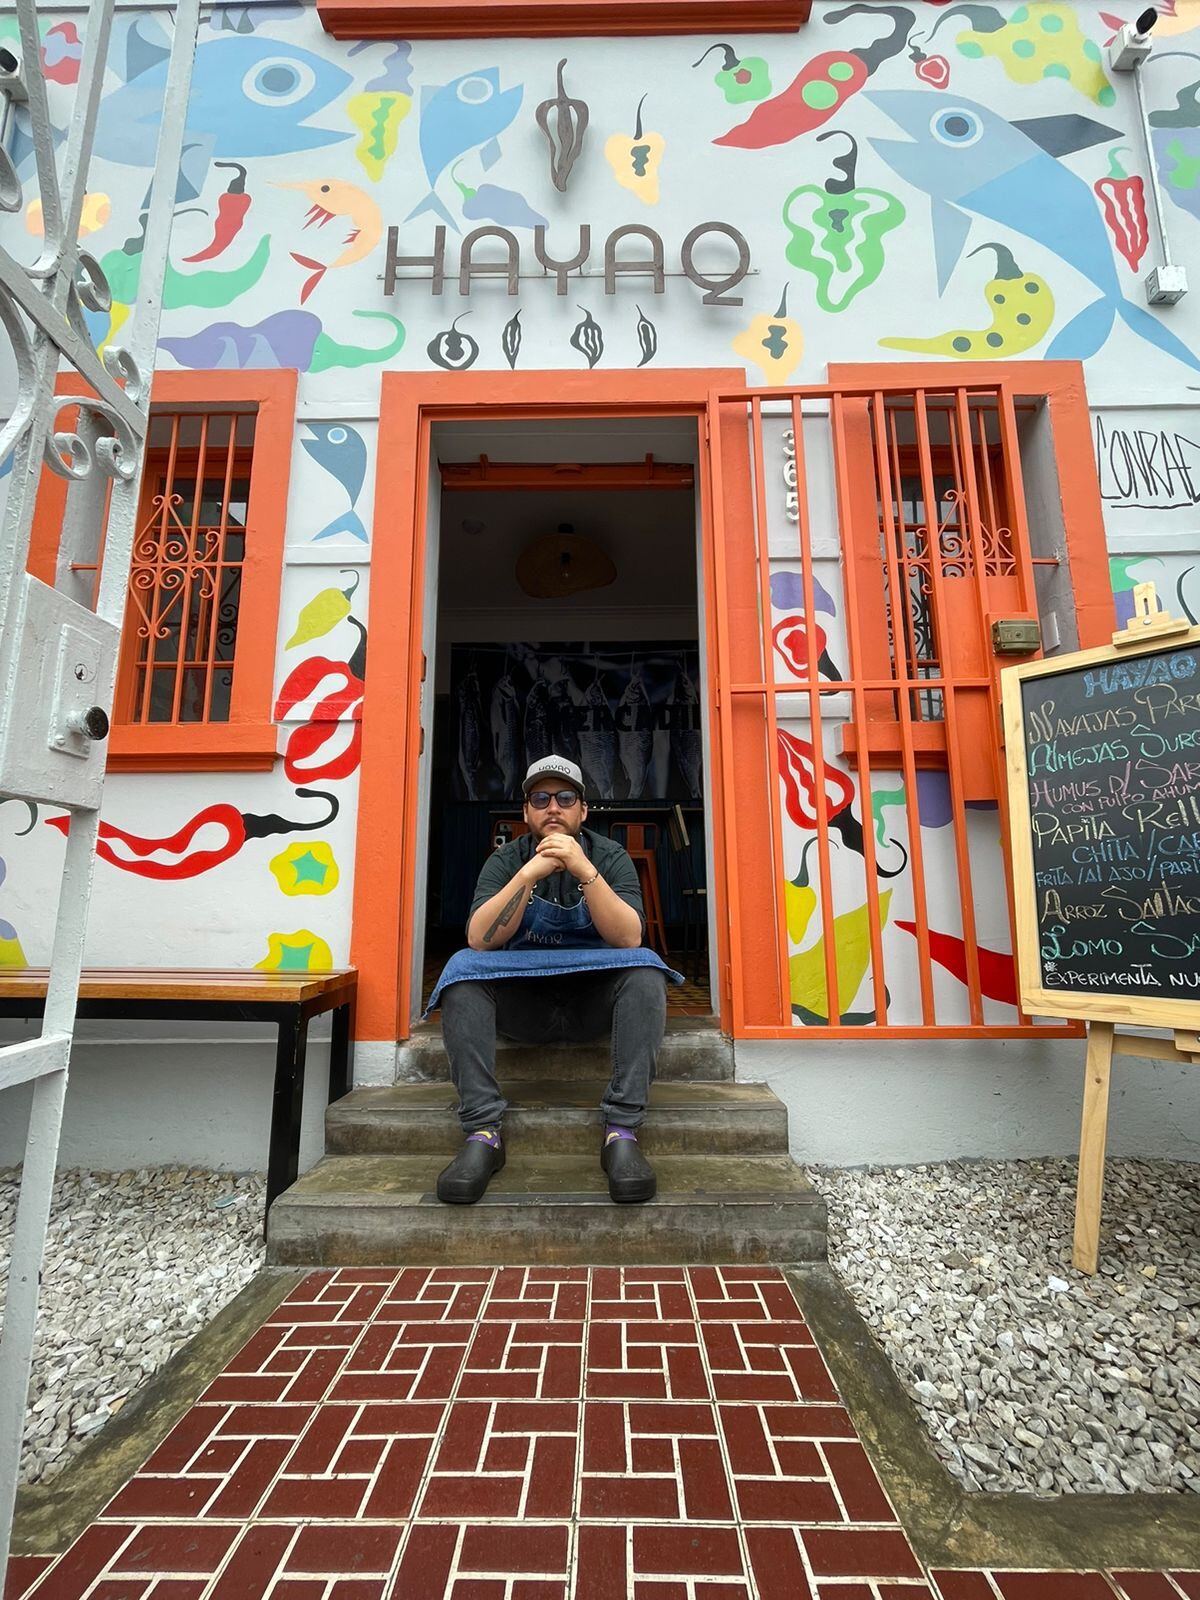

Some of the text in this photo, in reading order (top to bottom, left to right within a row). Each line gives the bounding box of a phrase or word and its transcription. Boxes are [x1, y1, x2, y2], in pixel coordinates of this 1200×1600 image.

[384, 222, 750, 306] HAYAQ
[782, 429, 800, 521] 365
[1084, 655, 1197, 697] HAYAQ
[1029, 700, 1137, 744] NAVAJAS
[1031, 780, 1101, 808] HUMUS
[1062, 800, 1094, 814] CON
[1041, 889, 1108, 924] ARROZ
[1041, 925, 1123, 960] LOMO
[1046, 964, 1200, 988] EXPERIMENTA NU
